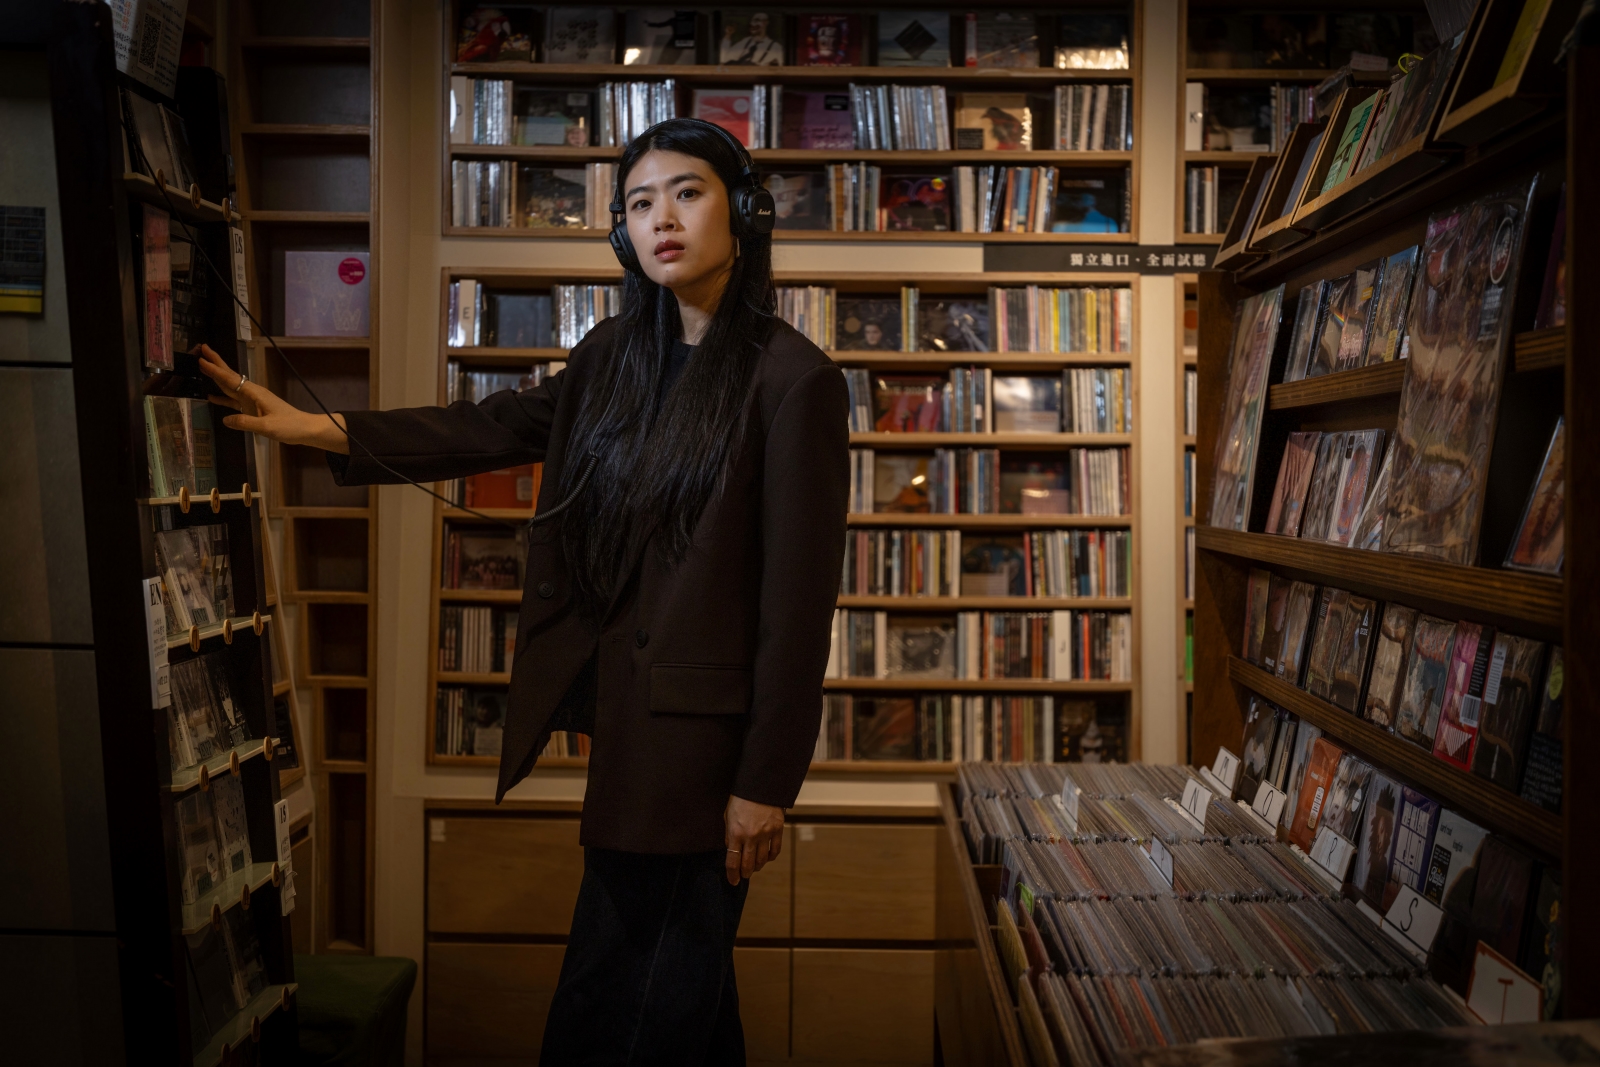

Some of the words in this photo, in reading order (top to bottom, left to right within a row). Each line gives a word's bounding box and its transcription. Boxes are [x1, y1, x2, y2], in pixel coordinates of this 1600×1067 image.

[1188, 787, 1200, 815] N
[1325, 837, 1338, 869] R
[1400, 897, 1418, 932] S
[1498, 978, 1514, 1024] T
